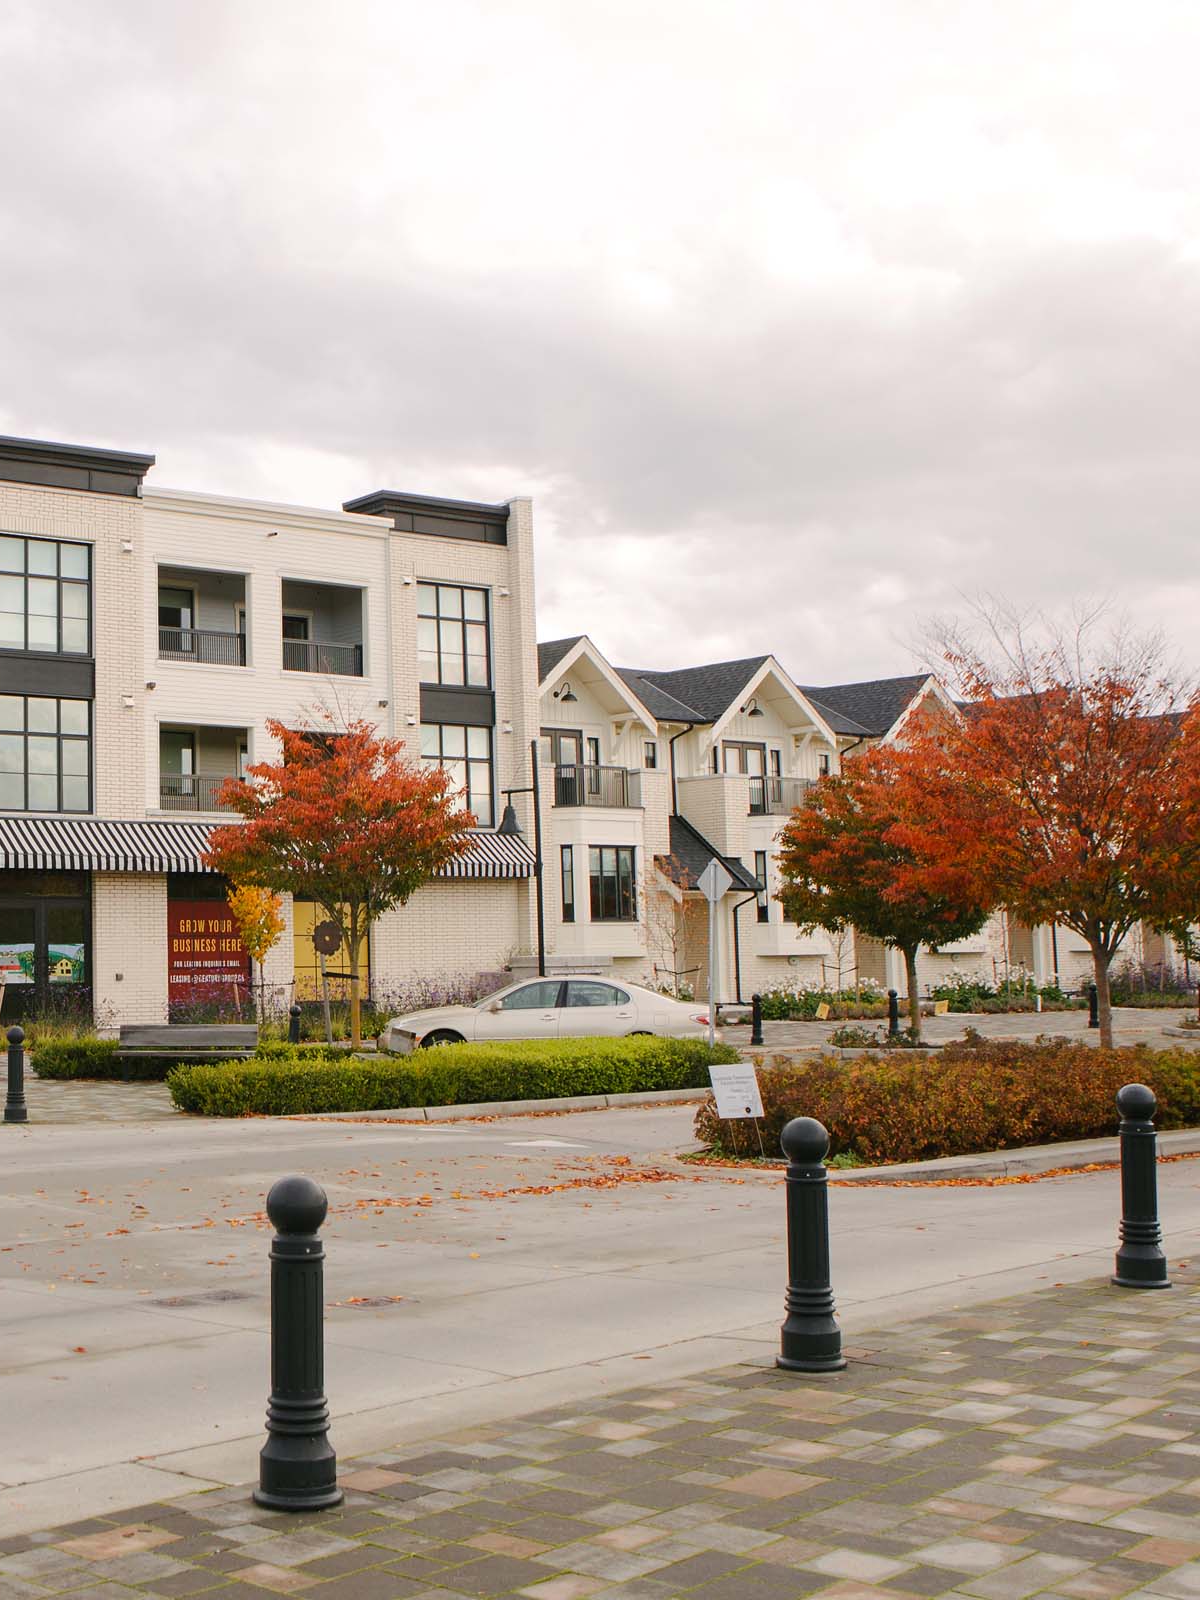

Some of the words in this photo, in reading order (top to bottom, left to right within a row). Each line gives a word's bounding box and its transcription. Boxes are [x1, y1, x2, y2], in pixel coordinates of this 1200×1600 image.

[180, 919, 205, 933] GROW
[208, 919, 232, 933] YOUR
[173, 939, 216, 952] BUSINESS
[220, 939, 242, 952] HERE
